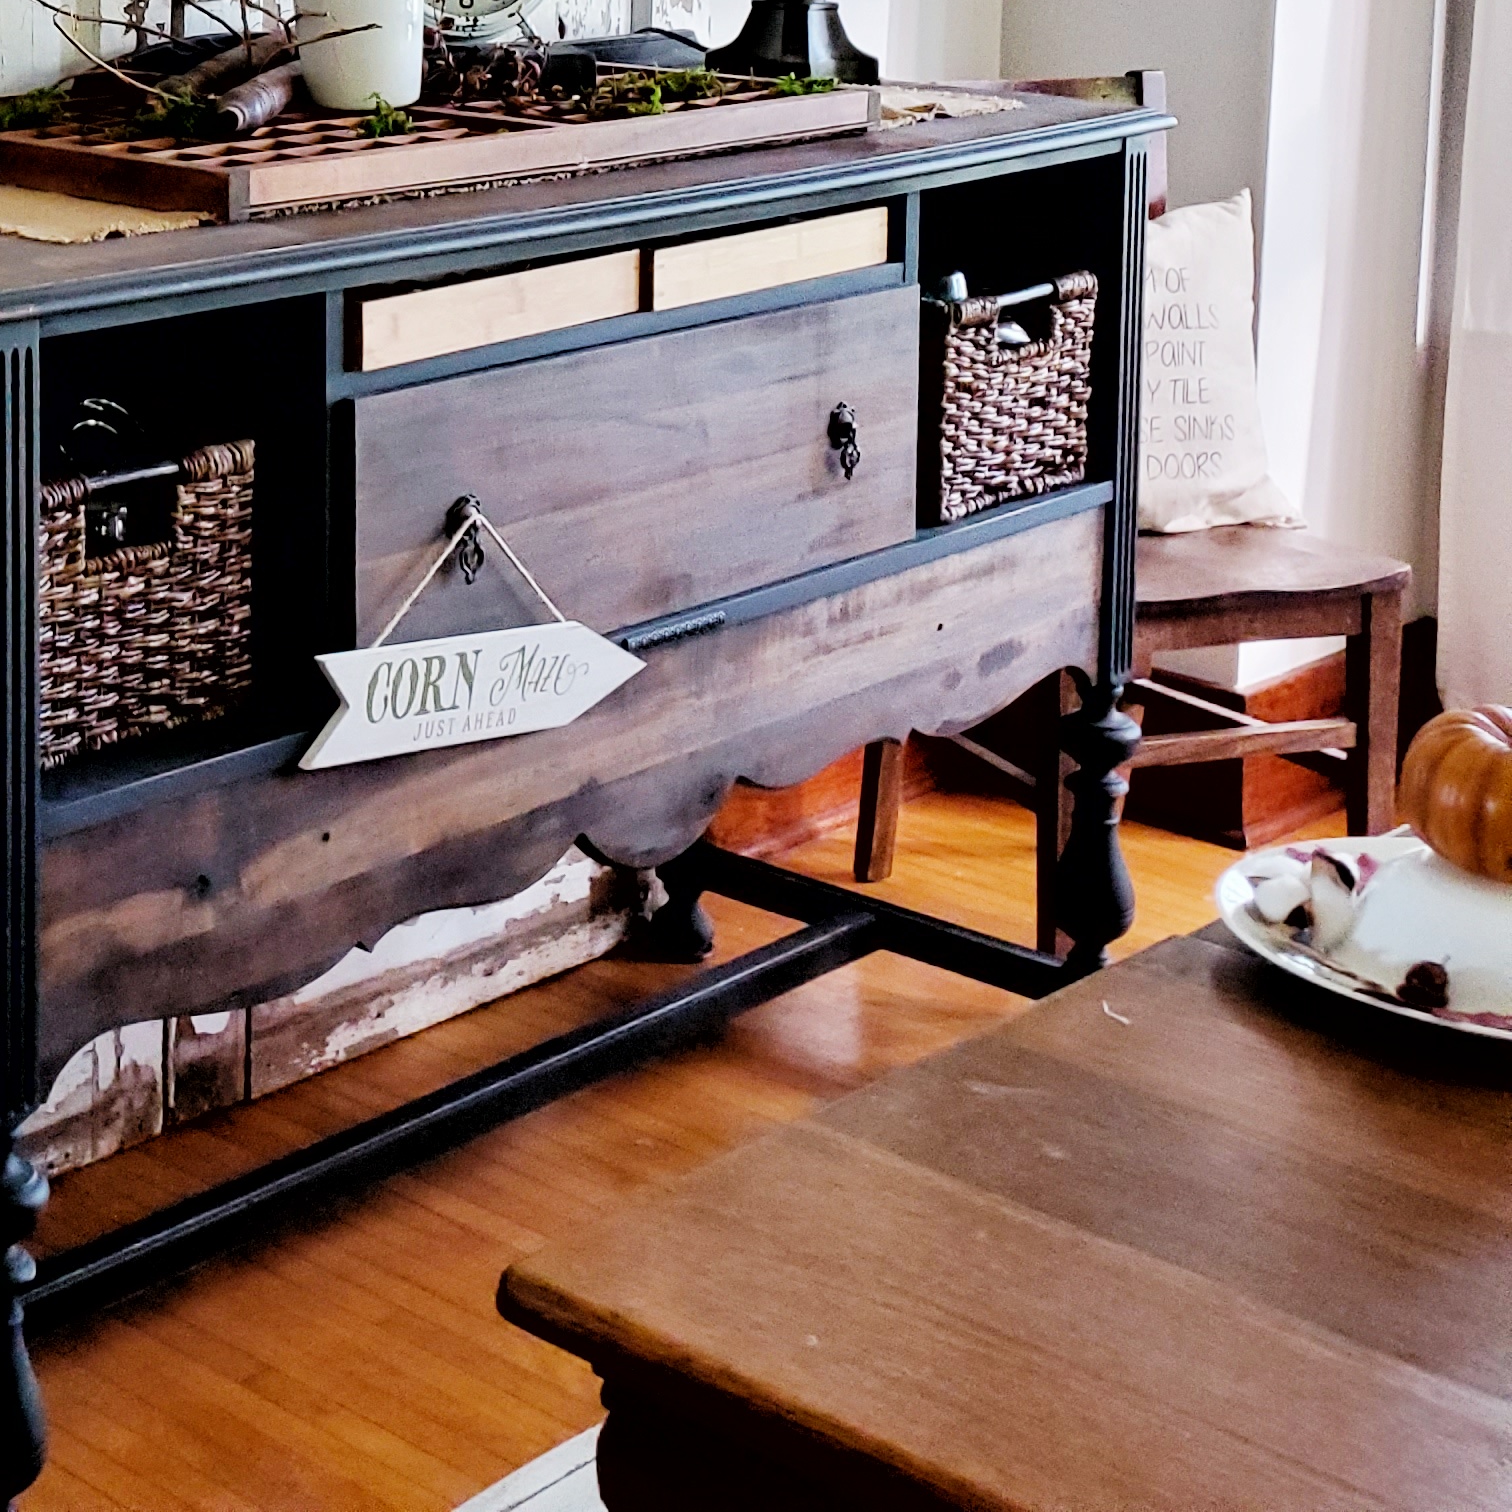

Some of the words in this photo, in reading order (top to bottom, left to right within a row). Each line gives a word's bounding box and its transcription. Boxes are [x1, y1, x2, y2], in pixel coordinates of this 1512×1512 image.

[1165, 267, 1191, 294] OF
[1169, 377, 1212, 405] TILE
[1146, 451, 1223, 481] DOORS
[366, 648, 483, 724] CORN
[412, 719, 455, 742] JUST
[461, 707, 517, 733] AHEAD
